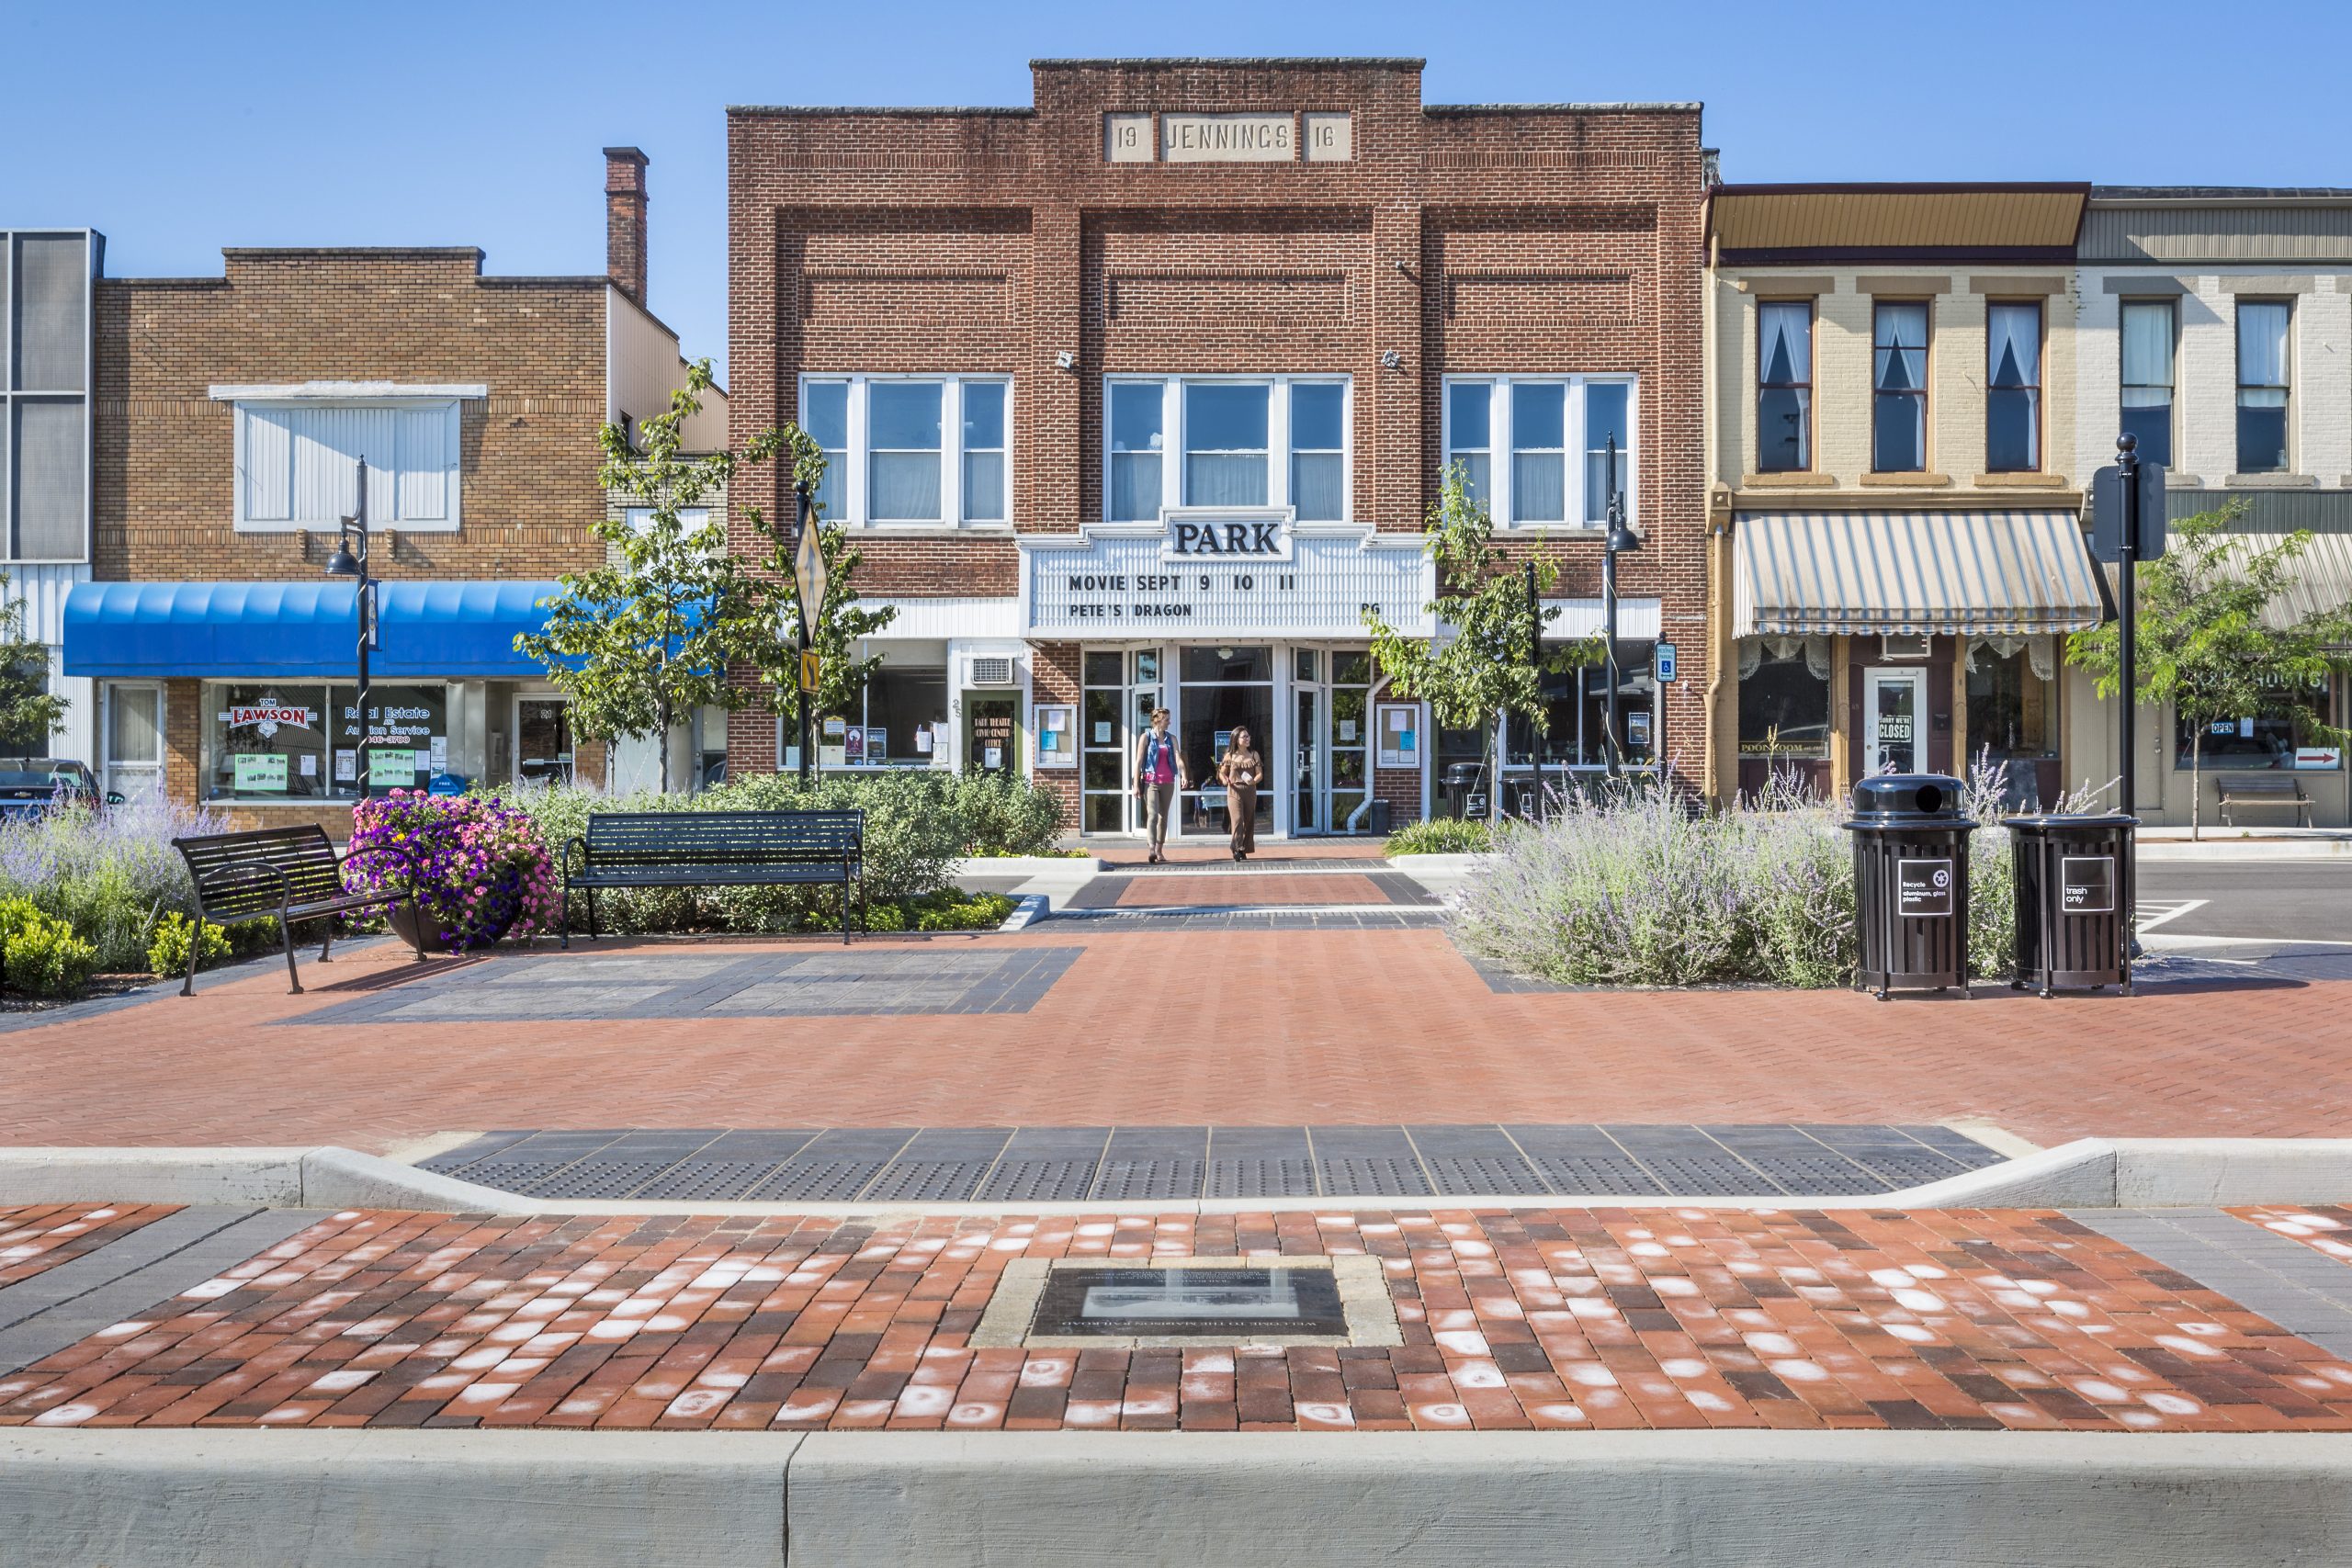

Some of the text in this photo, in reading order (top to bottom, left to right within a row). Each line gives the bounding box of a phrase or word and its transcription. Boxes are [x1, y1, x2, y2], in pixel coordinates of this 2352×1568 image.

[1118, 124, 1335, 150] 19 JENNINGS 16
[1175, 523, 1280, 553] PARK
[1069, 575, 1294, 591] MOVIE SEPT 9 10 11
[1070, 604, 1192, 617] PETE'S DRAGON
[233, 709, 305, 725] LAWSON
[384, 707, 430, 719] Estate
[540, 710, 551, 719] 21
[989, 717, 1011, 727] THEATRE
[390, 726, 430, 735] Service
[991, 728, 1010, 738] CENTER
[1879, 724, 1911, 739] CLOSED
[2212, 724, 2233, 733] OPEN
[2065, 896, 2084, 905] only
